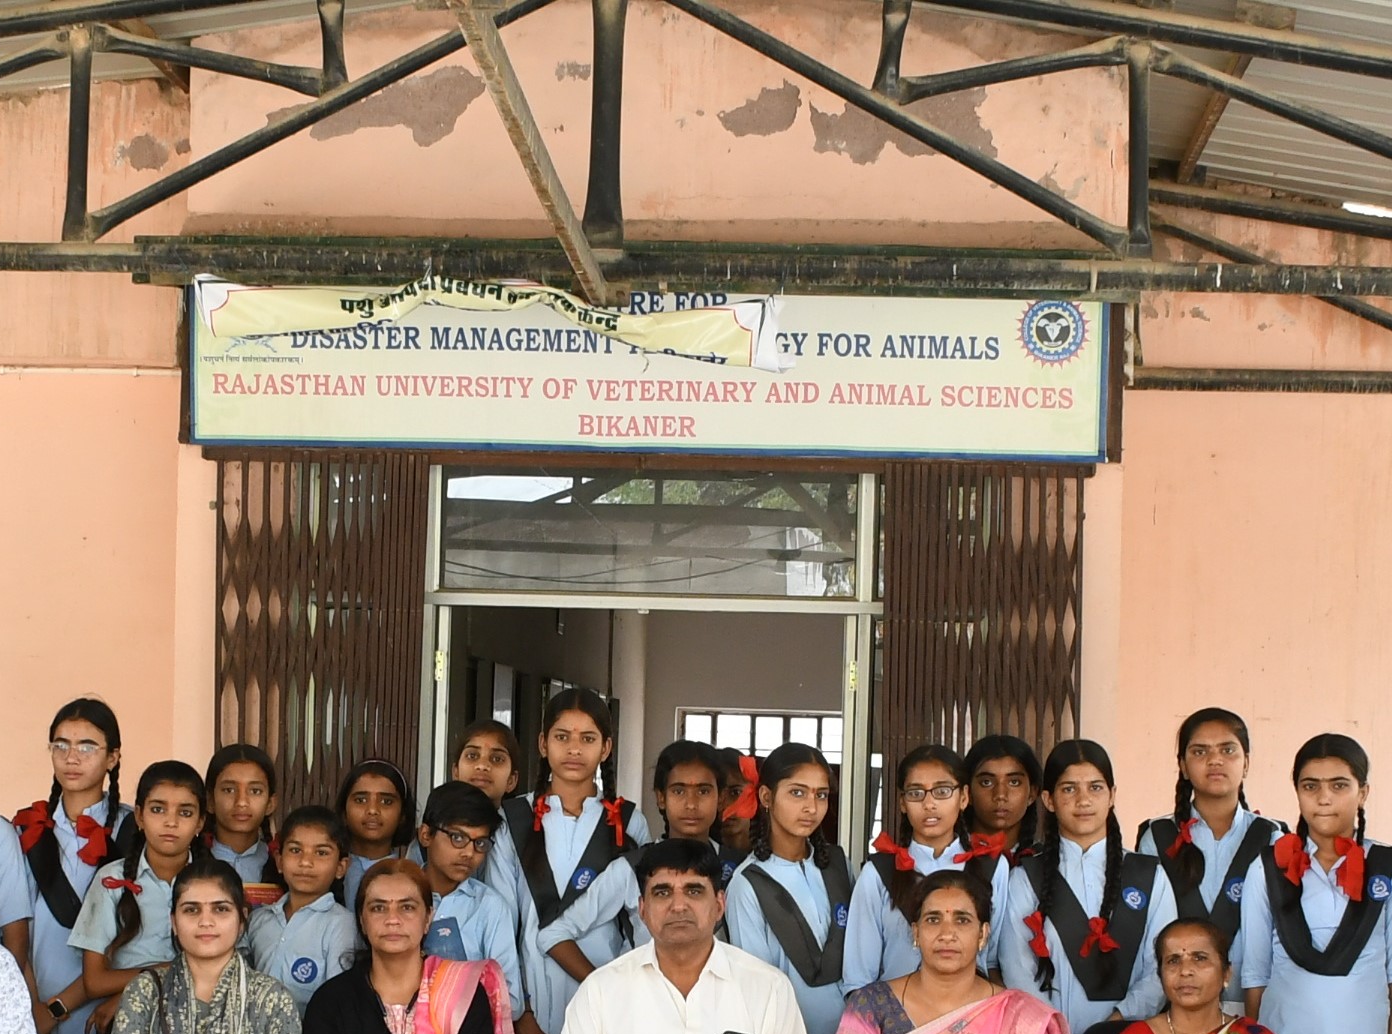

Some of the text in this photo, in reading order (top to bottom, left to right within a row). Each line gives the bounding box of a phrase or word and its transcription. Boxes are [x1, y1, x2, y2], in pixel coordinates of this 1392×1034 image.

[291, 326, 420, 350] DISASTER
[430, 326, 612, 354] MANAGEMENT
[817, 332, 871, 357] FOR
[880, 335, 1000, 360] ANIMALS
[212, 373, 1073, 409] RAJASTHAN UNIVERSITY OF VETERINARY AND ANIMAL SCIENCES
[578, 414, 696, 437] BIKANER
